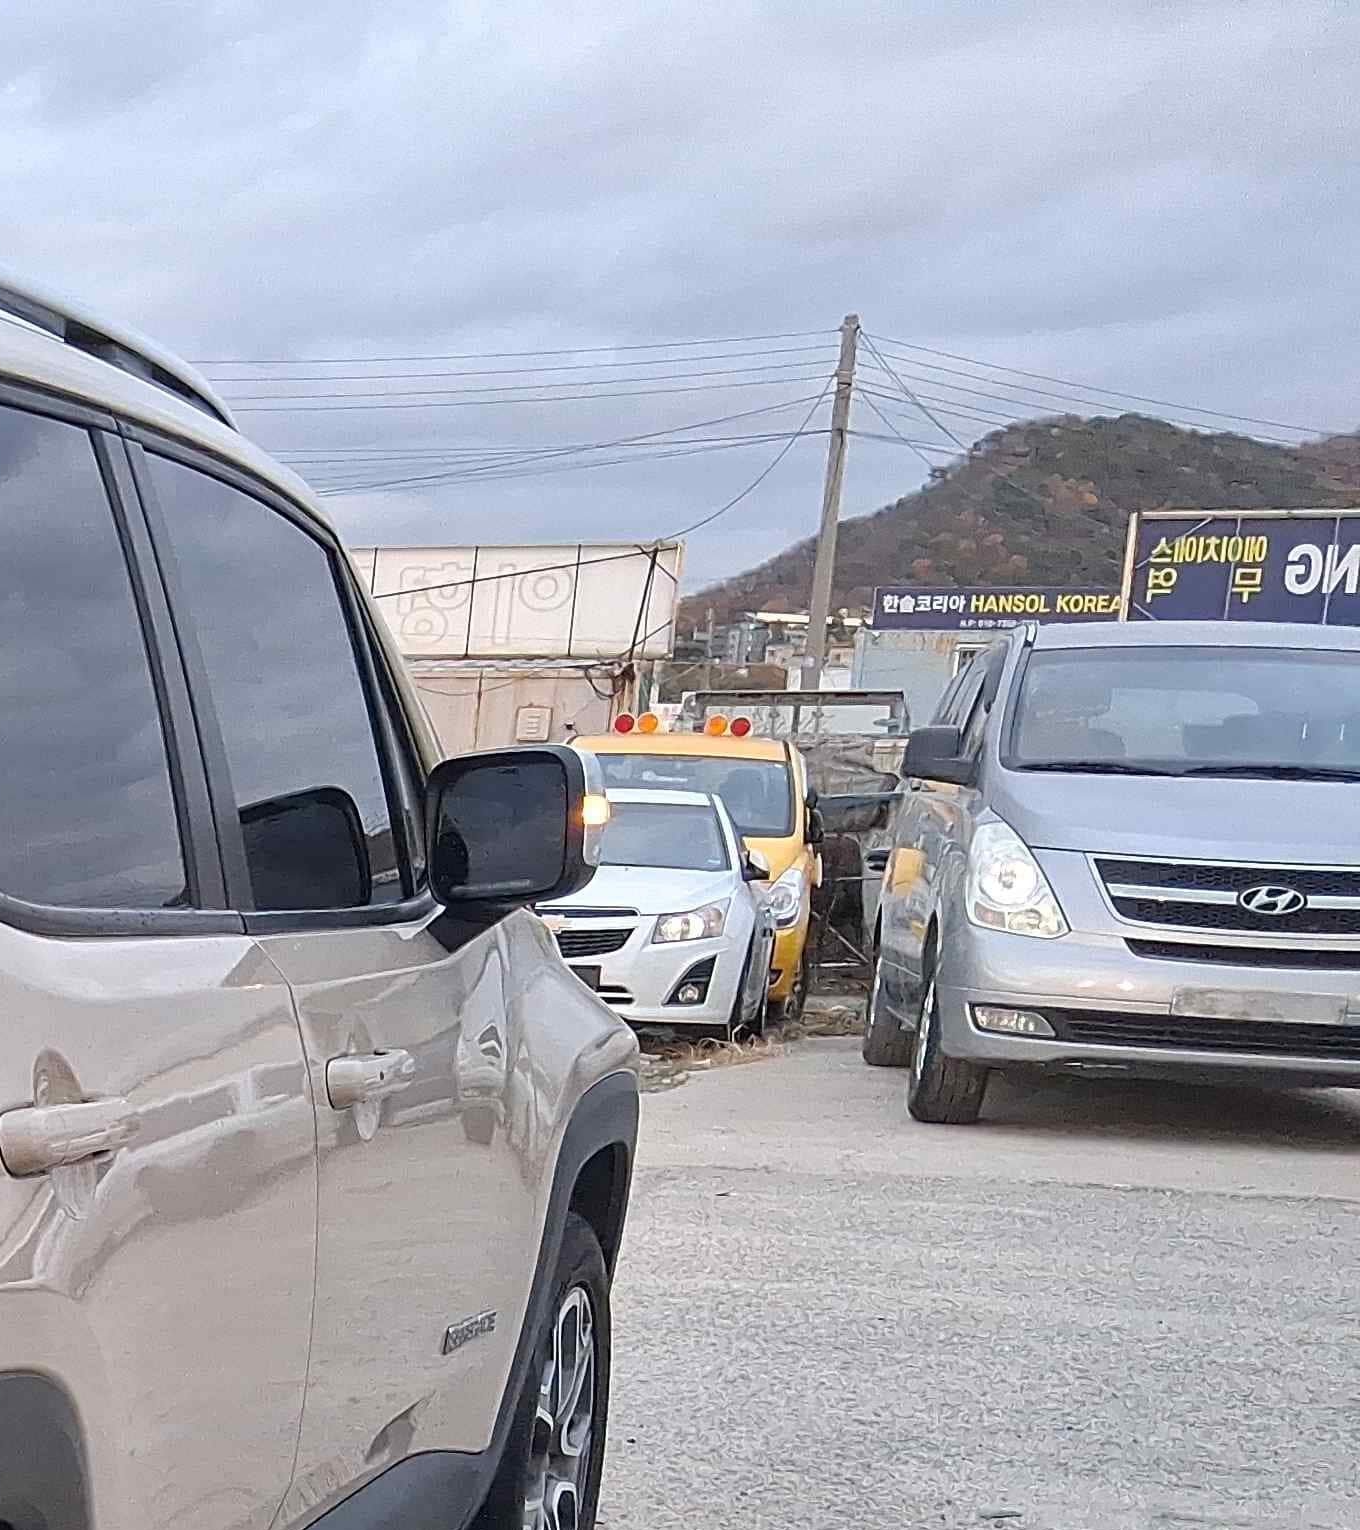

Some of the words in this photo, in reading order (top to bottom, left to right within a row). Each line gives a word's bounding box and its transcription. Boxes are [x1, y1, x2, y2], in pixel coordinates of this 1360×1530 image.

[883, 594, 966, 613] 한솔코리아
[970, 594, 1050, 613] HANSOL
[1056, 594, 1122, 613] KOREA
